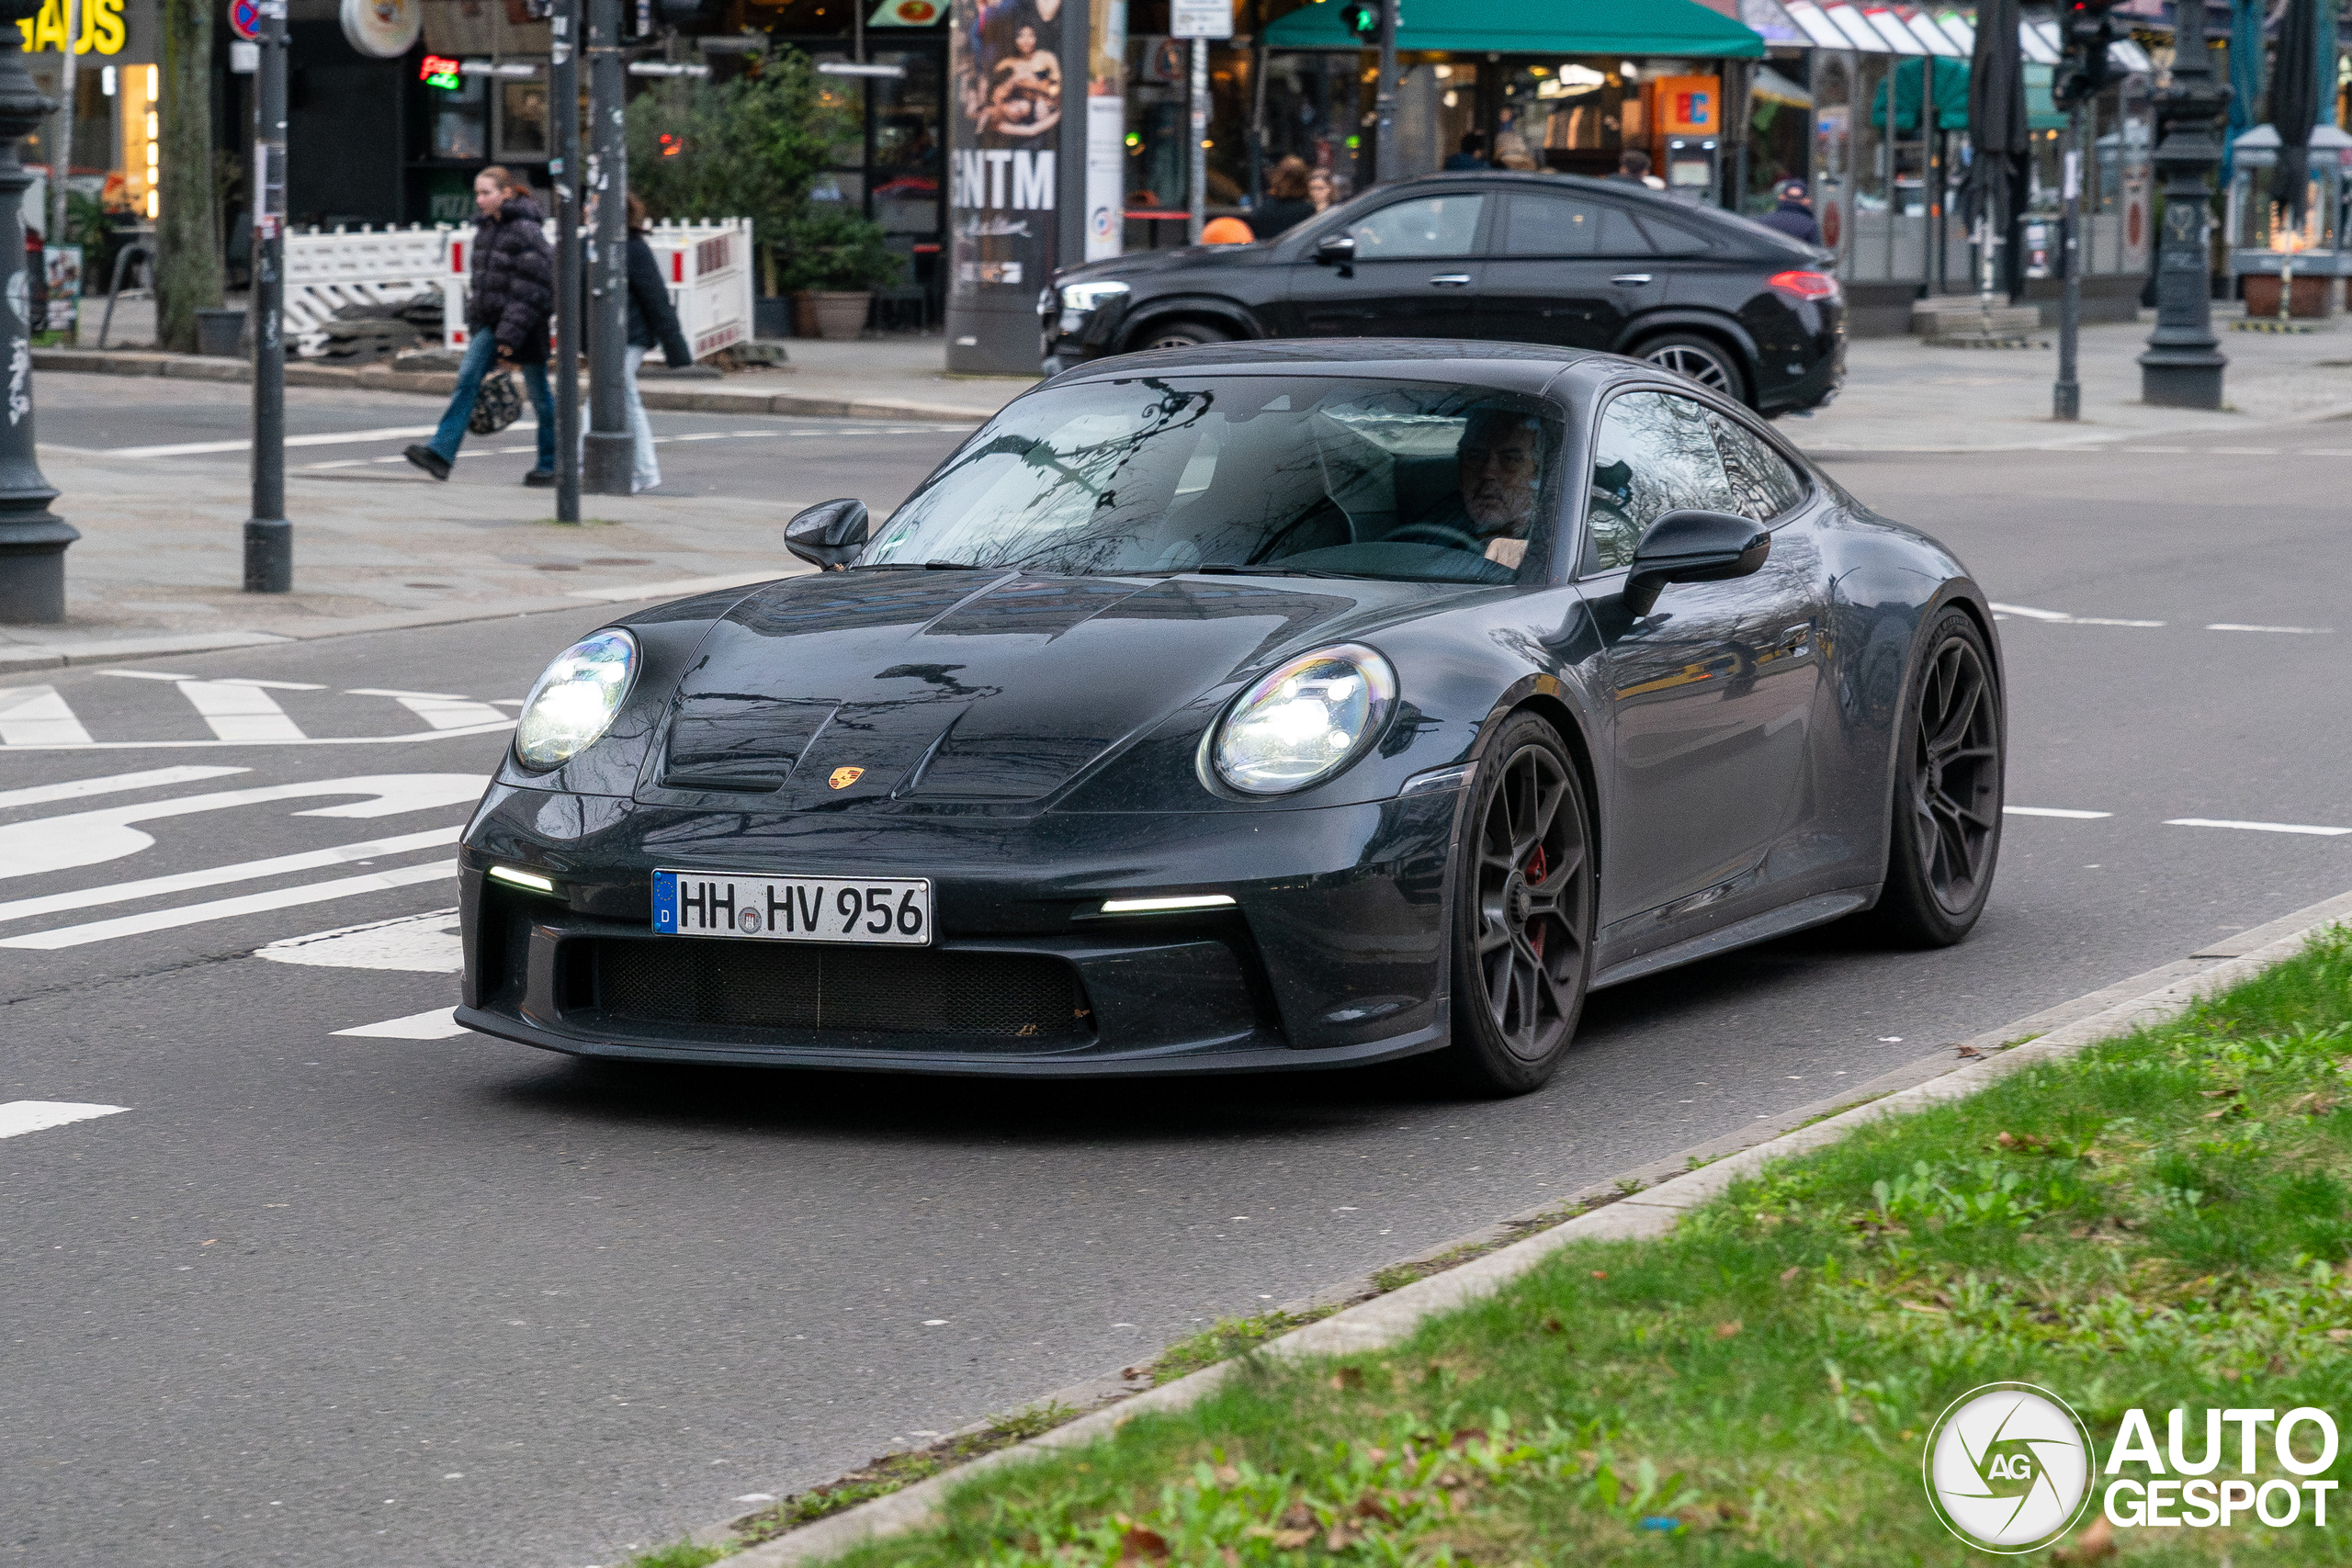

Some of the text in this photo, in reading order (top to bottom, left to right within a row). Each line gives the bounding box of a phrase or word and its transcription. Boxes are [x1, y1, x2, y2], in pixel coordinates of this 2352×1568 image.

[1677, 93, 1708, 124] EC
[661, 909, 671, 923] D
[680, 880, 923, 935] HH HV 956
